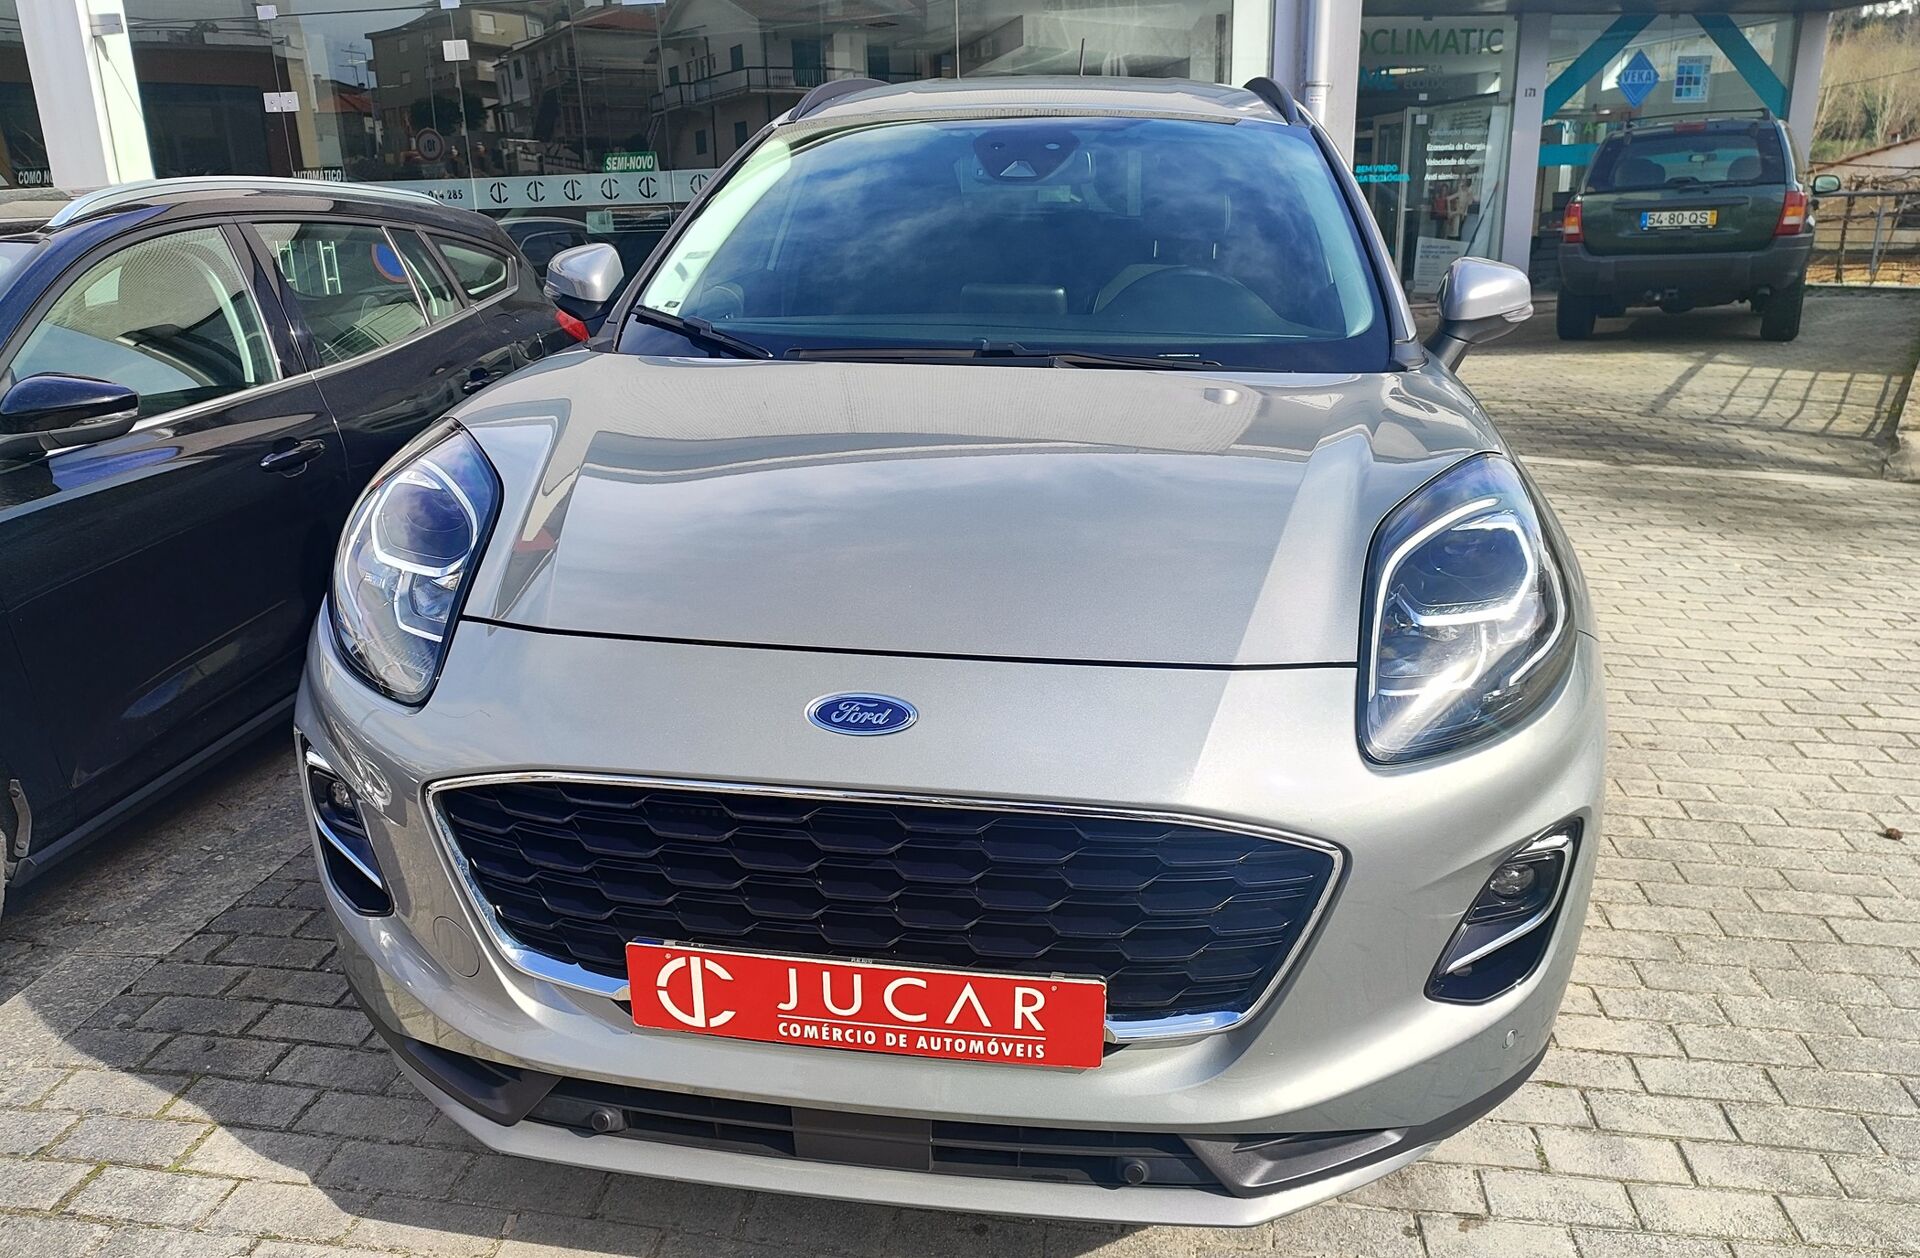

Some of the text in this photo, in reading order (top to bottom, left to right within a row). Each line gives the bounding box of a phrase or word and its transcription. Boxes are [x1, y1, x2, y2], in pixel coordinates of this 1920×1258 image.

[1624, 71, 1652, 82] VEKA
[606, 155, 654, 171] SEMI-NOVO
[18, 170, 42, 184] COMO
[292, 165, 342, 182] AUTOMÁTICO
[447, 189, 463, 199] 285
[831, 701, 892, 725] Ford
[776, 967, 1046, 1032] JUCAR
[778, 1021, 1046, 1060] COMÉRCIO DE AUTOMÓVEIS
